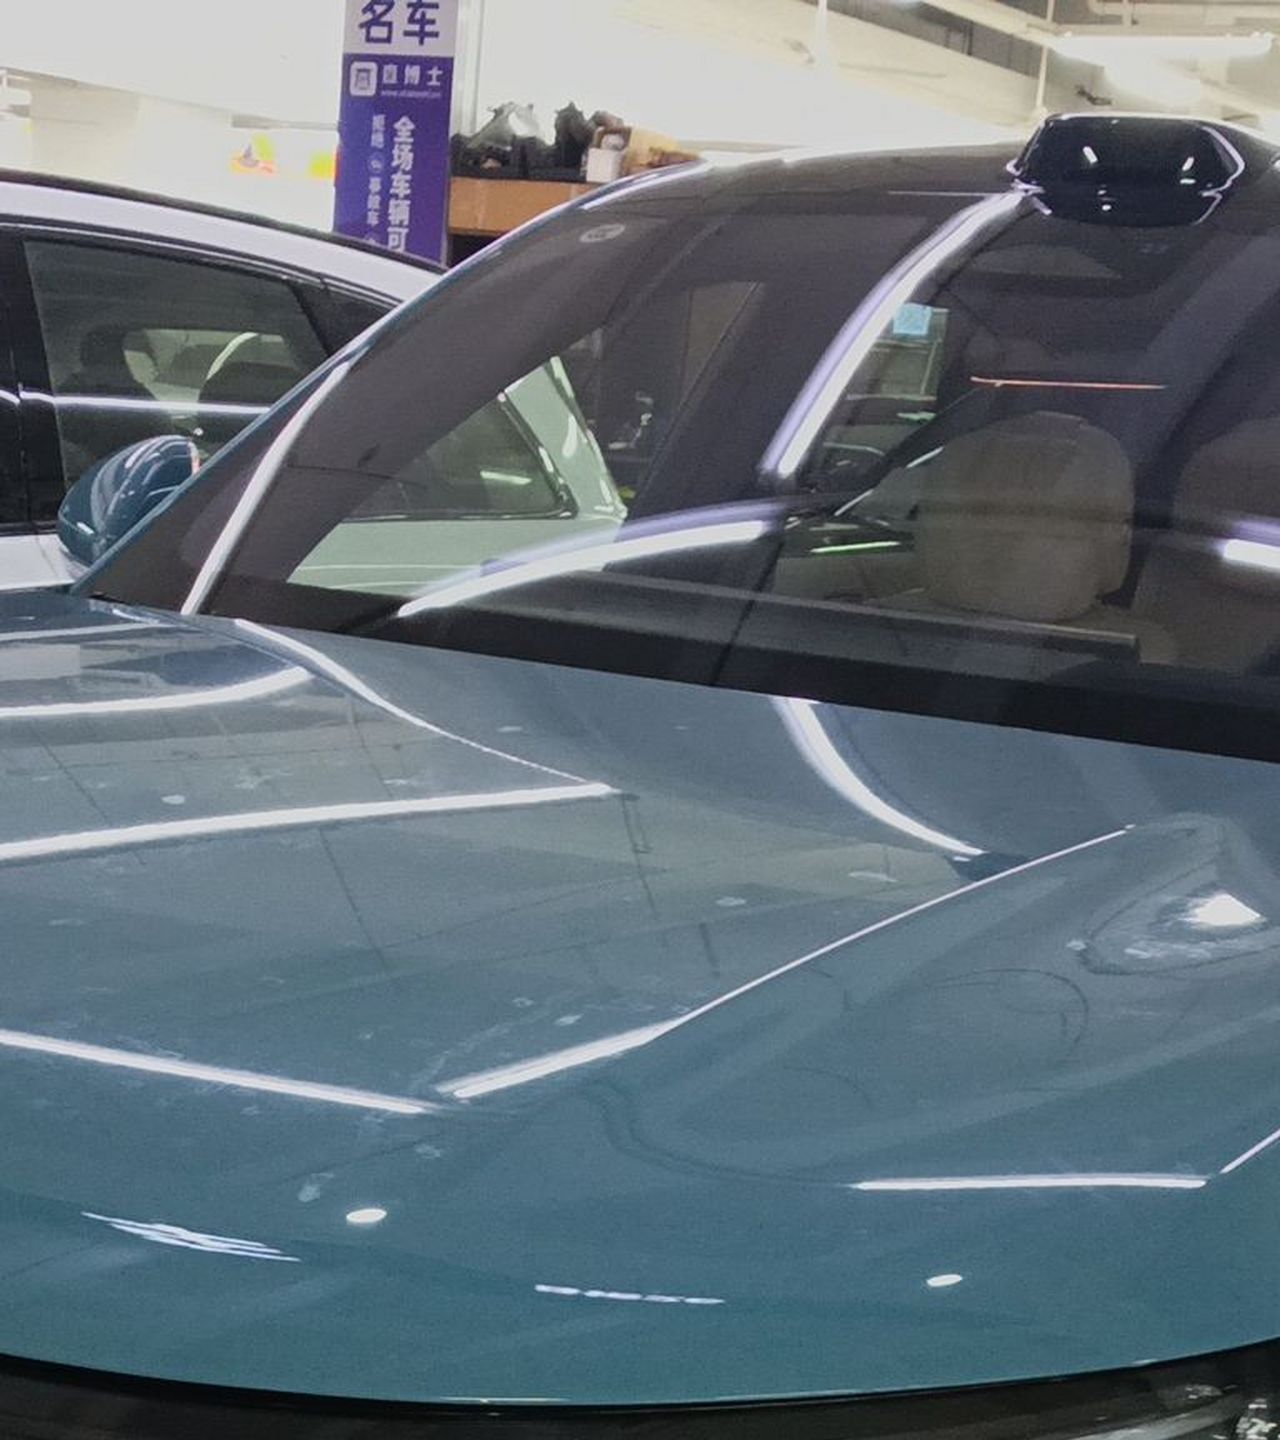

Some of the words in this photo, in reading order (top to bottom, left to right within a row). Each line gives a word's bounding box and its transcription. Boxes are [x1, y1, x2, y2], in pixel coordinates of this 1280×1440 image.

[358, 0, 440, 46] 名车
[387, 115, 416, 252] 全场车辆可
